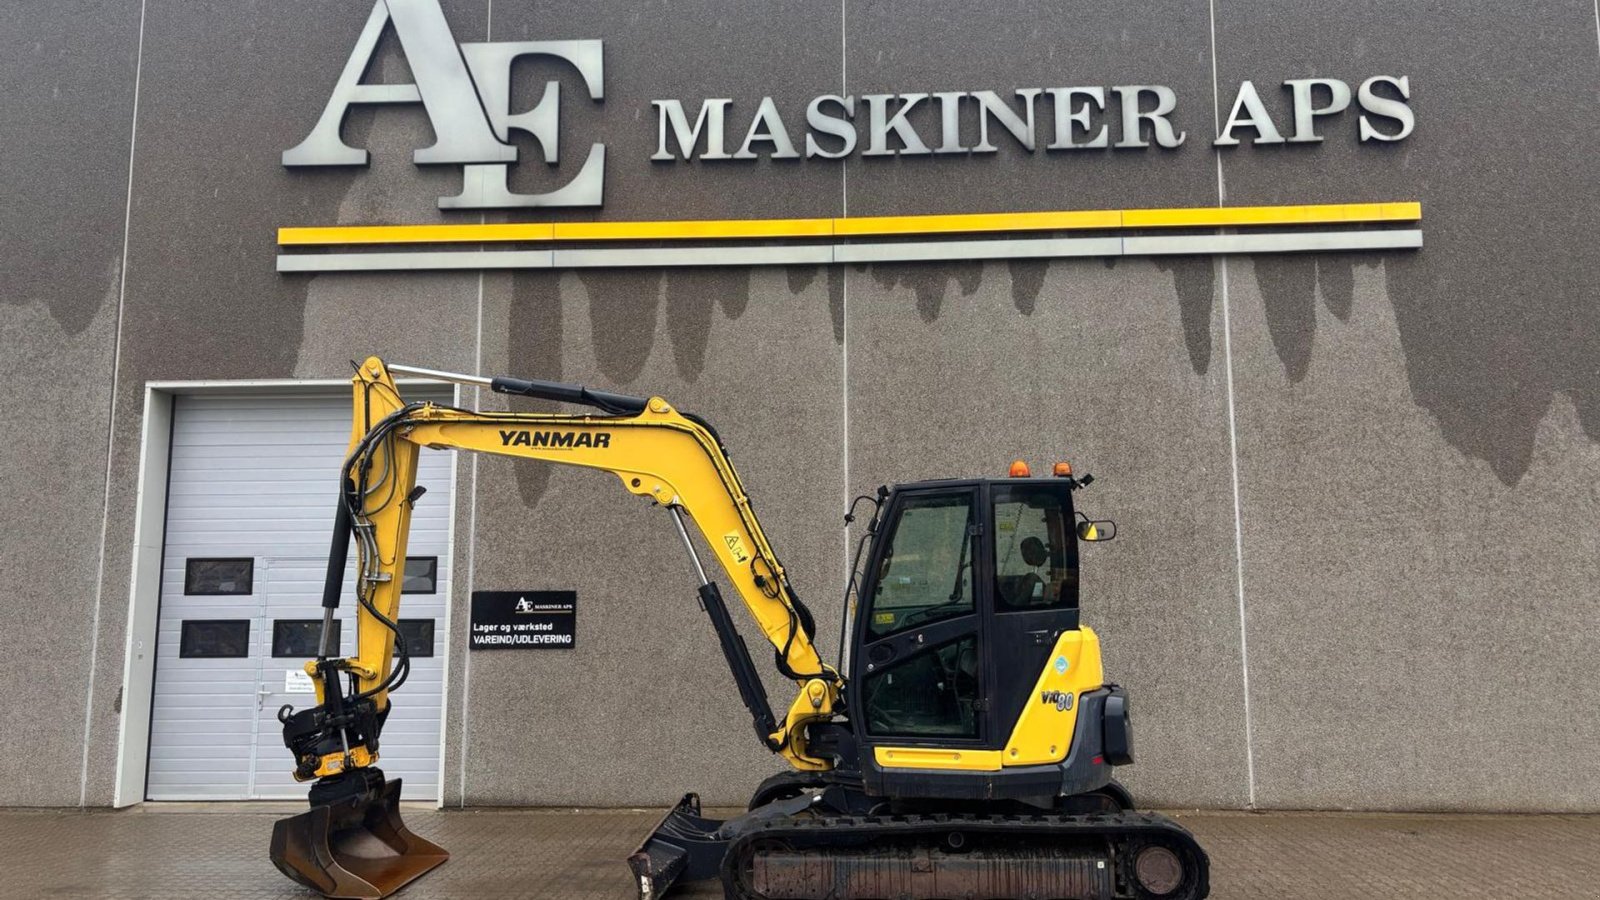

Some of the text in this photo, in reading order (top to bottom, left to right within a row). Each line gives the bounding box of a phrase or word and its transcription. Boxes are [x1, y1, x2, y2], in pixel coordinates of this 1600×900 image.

[281, 0, 1415, 210] AE MASKINER APS
[499, 430, 611, 448] YANMAR
[515, 596, 534, 612] AE
[473, 622, 553, 633] Lager og værksted
[473, 634, 572, 645] VAREIND/UDLEVERING
